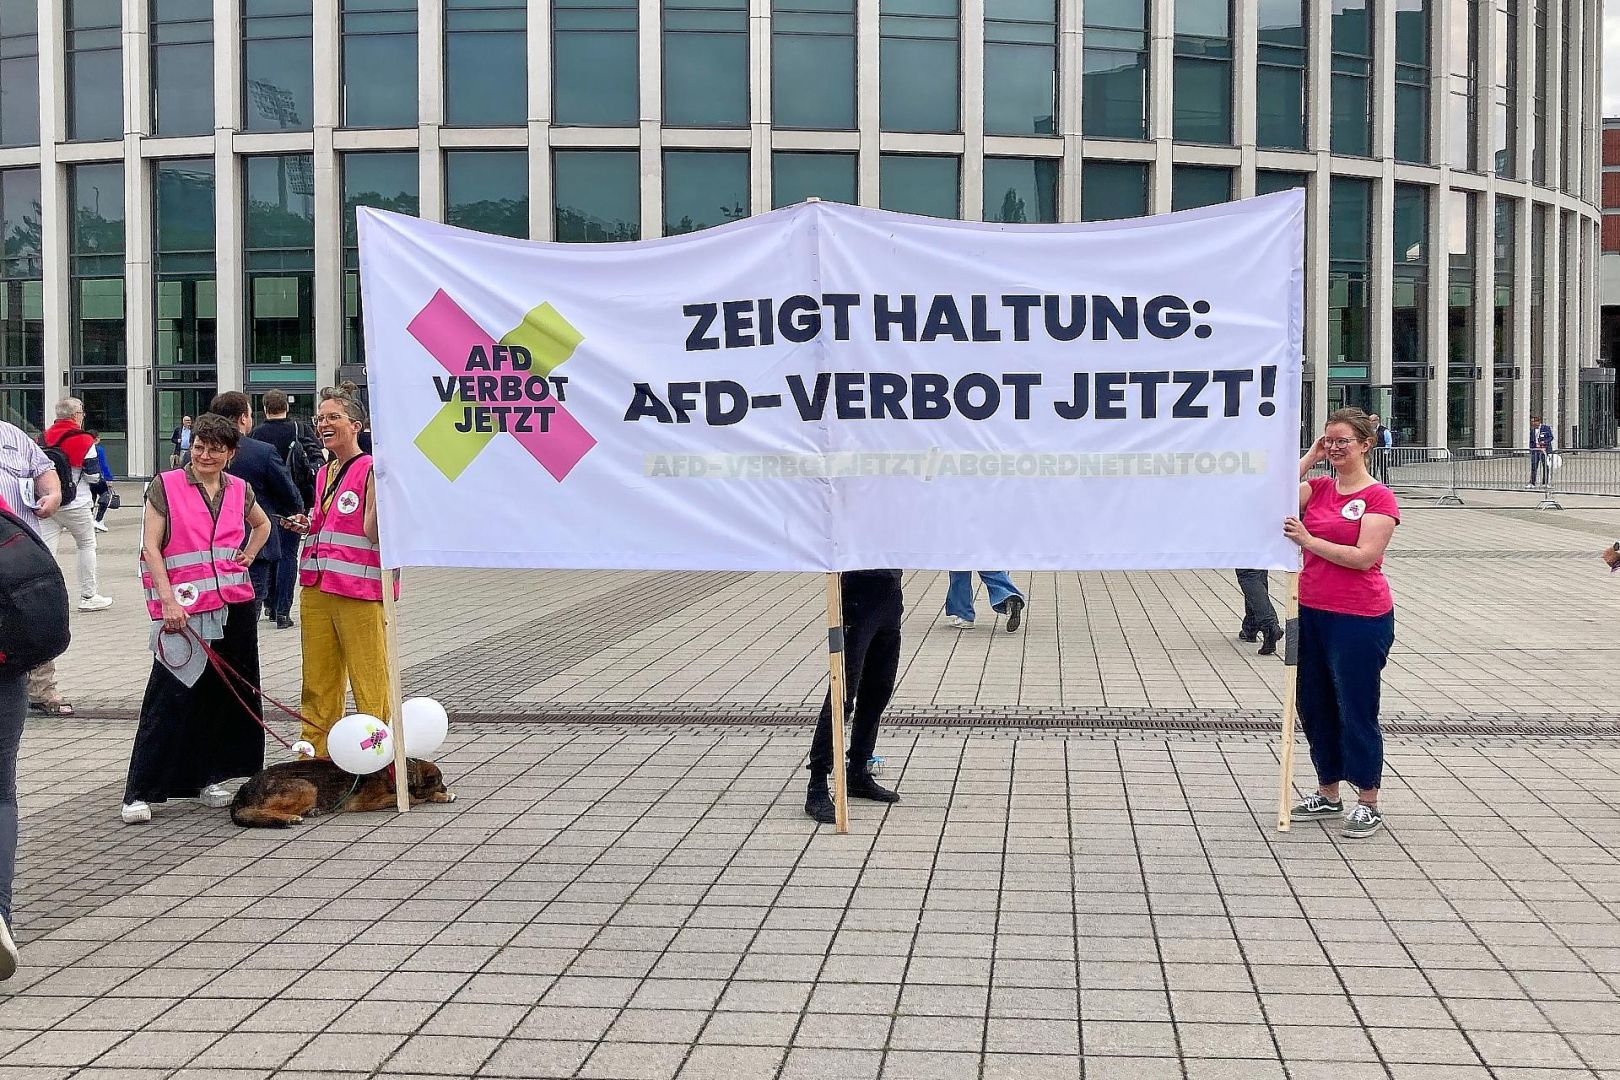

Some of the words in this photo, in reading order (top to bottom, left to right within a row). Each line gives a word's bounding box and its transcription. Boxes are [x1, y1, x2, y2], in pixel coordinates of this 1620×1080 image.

[683, 294, 861, 352] ZEIGT
[873, 294, 1212, 342] HALTUNG:
[465, 345, 532, 372] AFD
[433, 375, 569, 402] VERBOT
[623, 372, 1042, 426] AFD-VERBOT
[1054, 364, 1277, 420] JETZT!
[454, 406, 556, 433] JETZT
